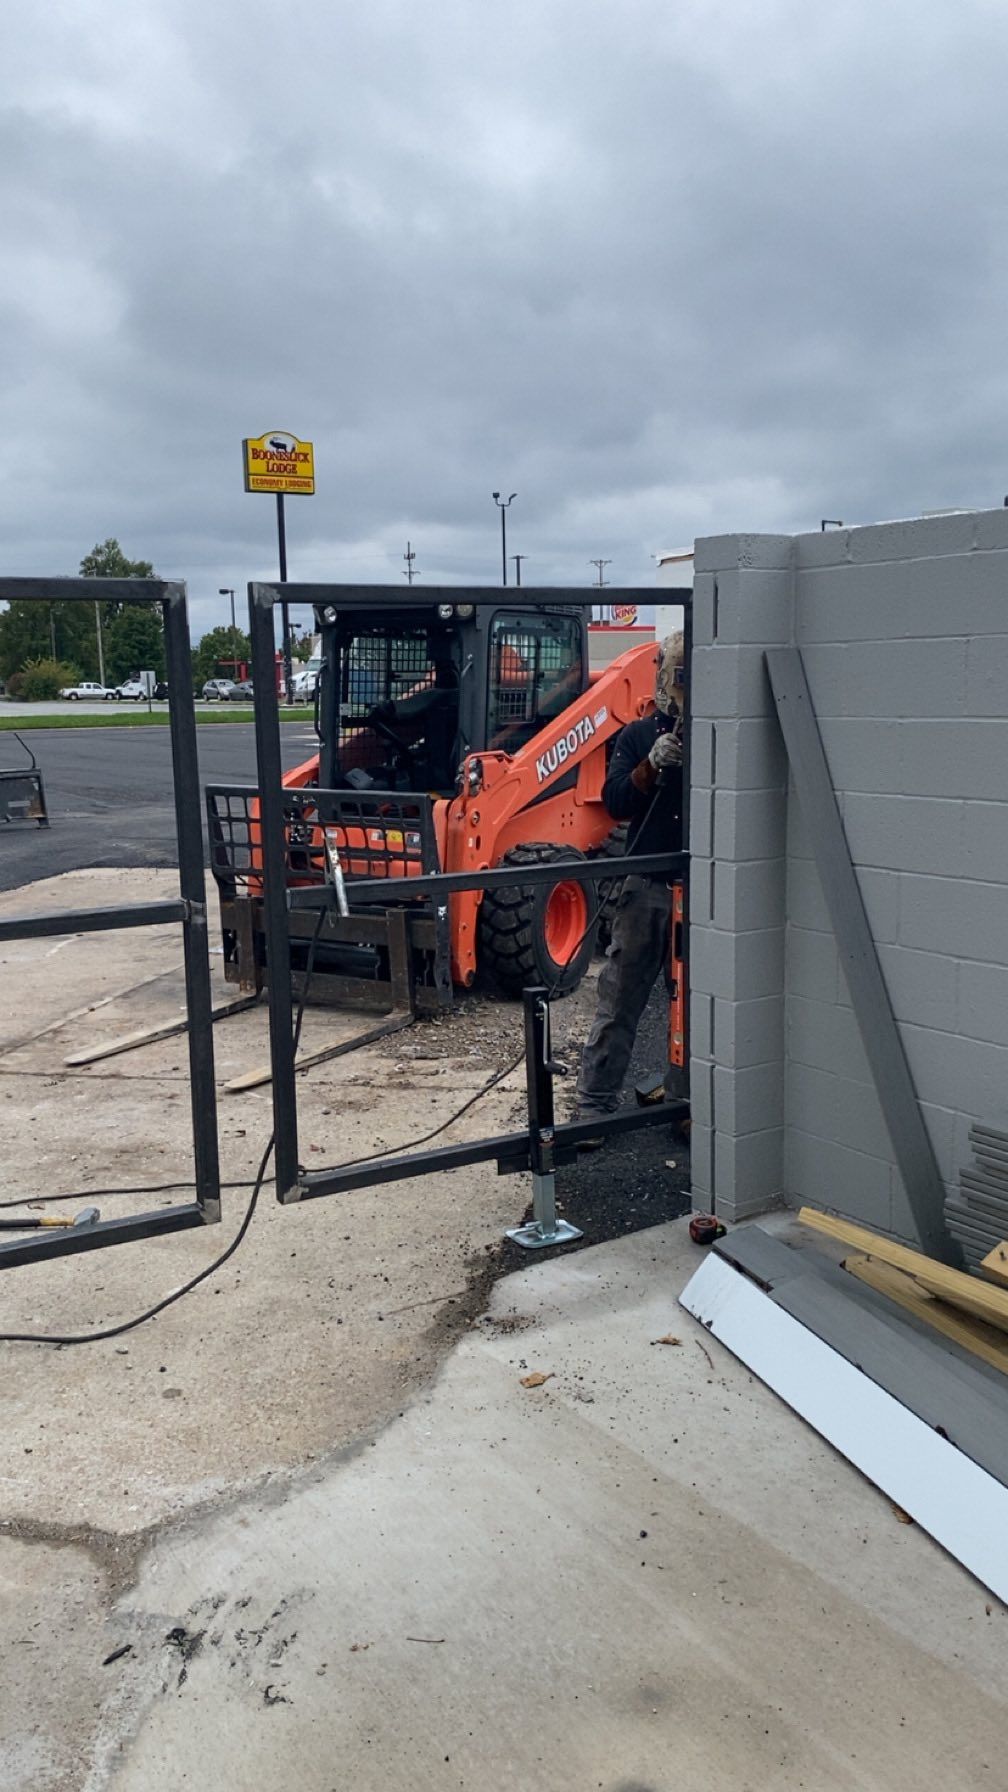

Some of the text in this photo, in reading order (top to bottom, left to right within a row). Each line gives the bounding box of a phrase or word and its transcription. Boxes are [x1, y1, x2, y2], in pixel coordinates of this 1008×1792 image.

[251, 447, 310, 463] BOONESLICK
[266, 461, 298, 474] LODGE
[615, 605, 637, 620] KING
[536, 716, 595, 784] KUBOTA
